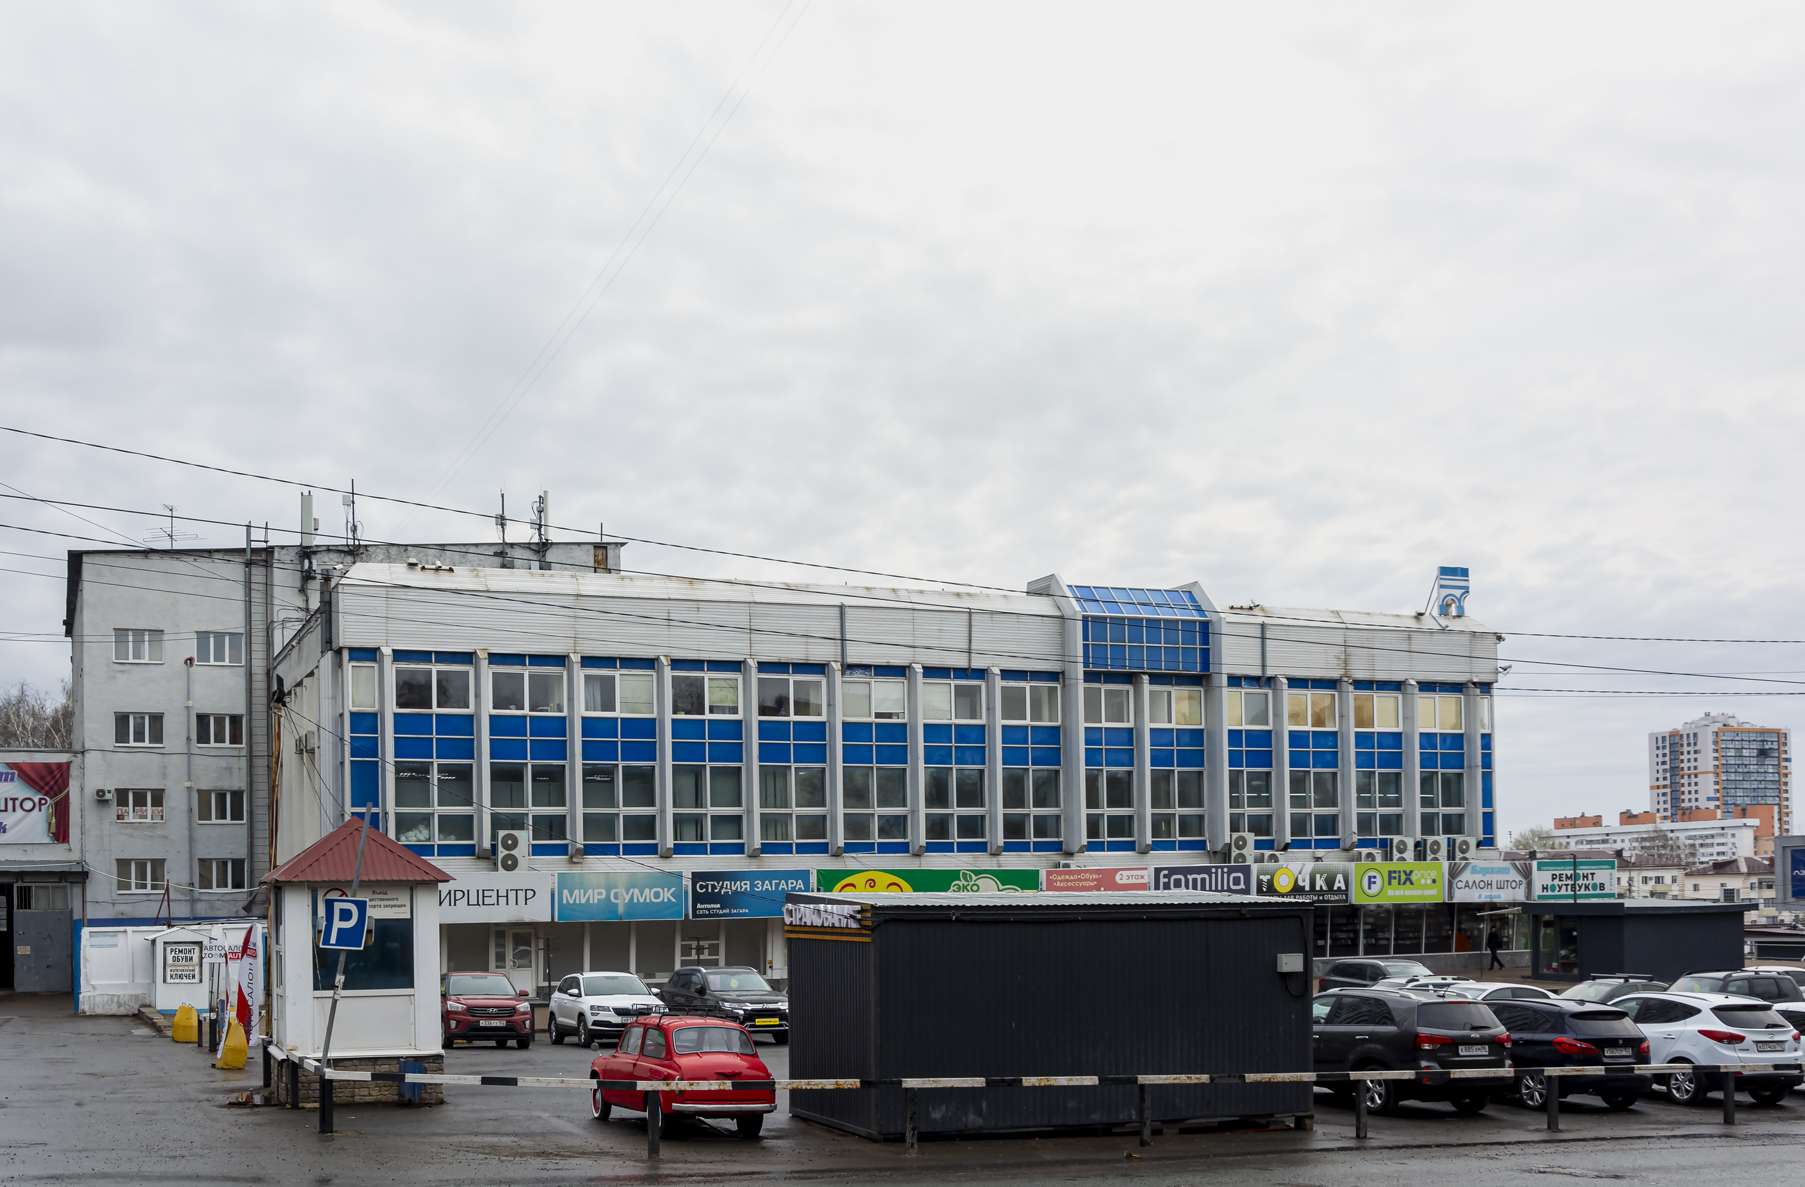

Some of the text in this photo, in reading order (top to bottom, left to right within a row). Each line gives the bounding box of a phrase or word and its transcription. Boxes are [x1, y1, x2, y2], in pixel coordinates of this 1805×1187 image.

[1080, 872, 1099, 880] Обувь
[1160, 867, 1246, 891] familia
[1259, 867, 1346, 893] ТОЧКА
[1456, 879, 1523, 889] САЛОН ШТОР
[563, 887, 677, 904] МИР СУМОК
[696, 880, 805, 895] СТУДИЯ ЗАГАРА
[952, 883, 980, 892] ЭКО
[438, 888, 536, 907] ИРЦЕНТР
[330, 902, 358, 944] P
